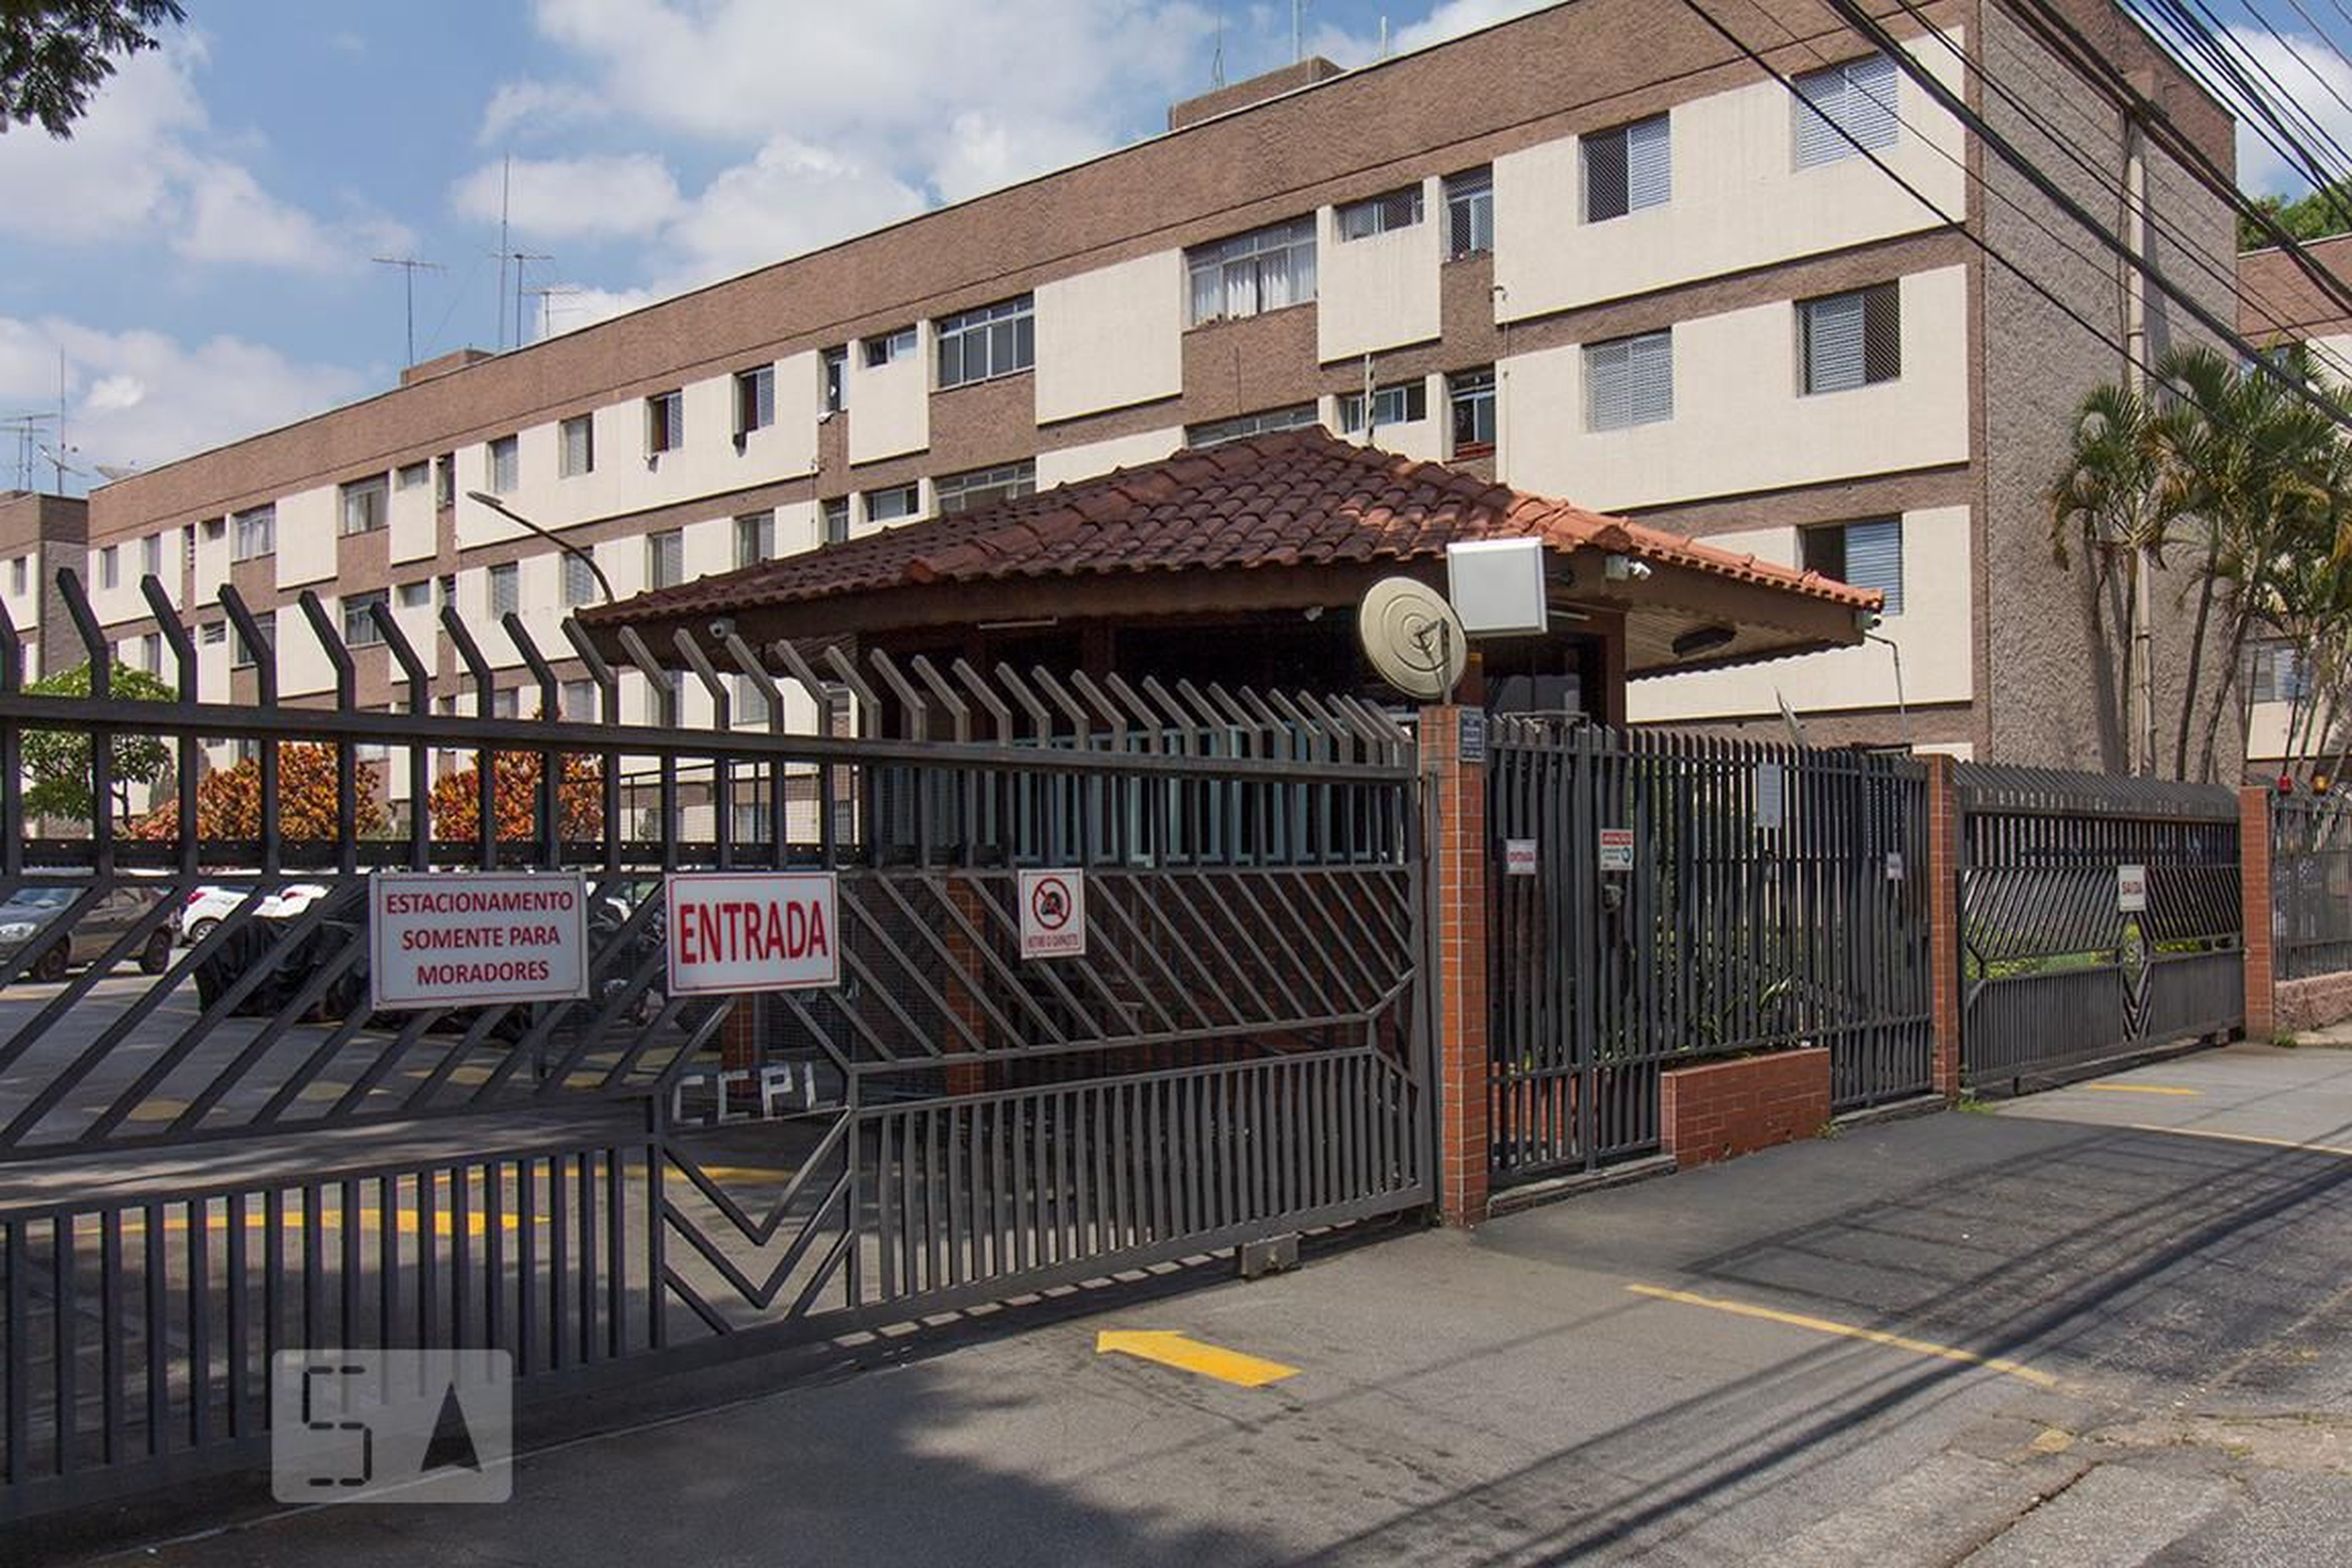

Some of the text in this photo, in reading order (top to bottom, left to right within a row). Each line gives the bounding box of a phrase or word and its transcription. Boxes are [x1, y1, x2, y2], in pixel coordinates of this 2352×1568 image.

[386, 891, 573, 914] ESTACIONAMENTO
[402, 925, 560, 950] SOMENTE PARA
[679, 900, 828, 964] ENTRADA
[417, 960, 548, 986] MORADORES
